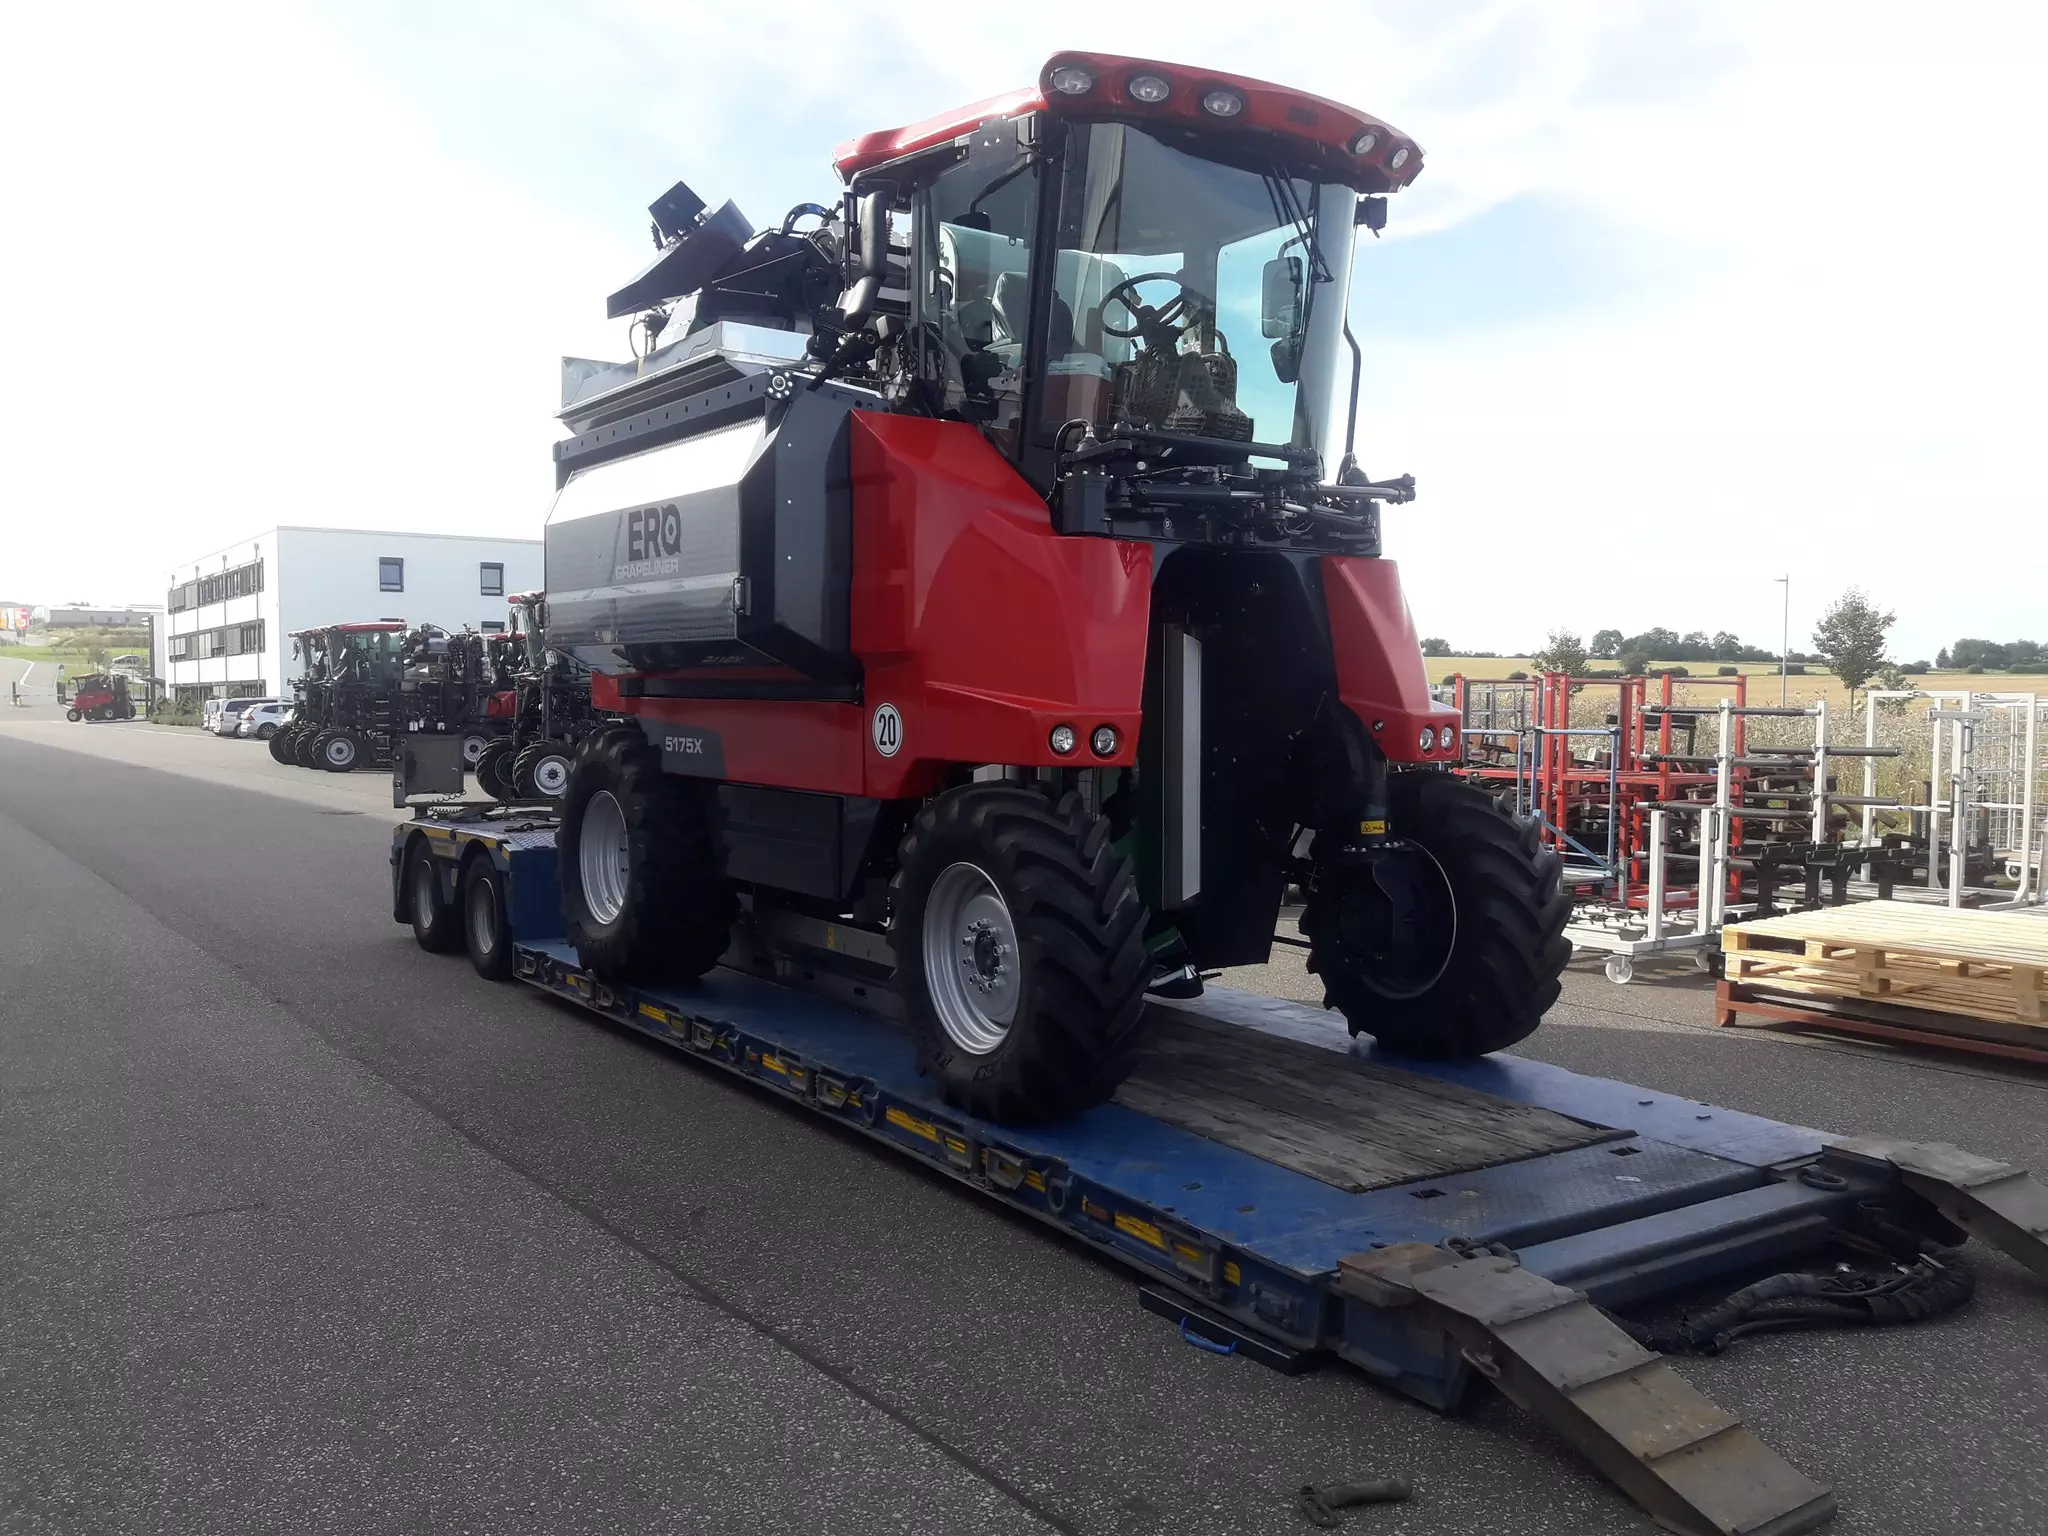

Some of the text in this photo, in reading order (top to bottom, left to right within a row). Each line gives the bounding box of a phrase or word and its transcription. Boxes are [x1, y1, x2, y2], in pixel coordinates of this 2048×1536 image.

[616, 560, 679, 580] GRAPELINER
[878, 713, 896, 747] 20
[665, 736, 703, 754] 5175X
